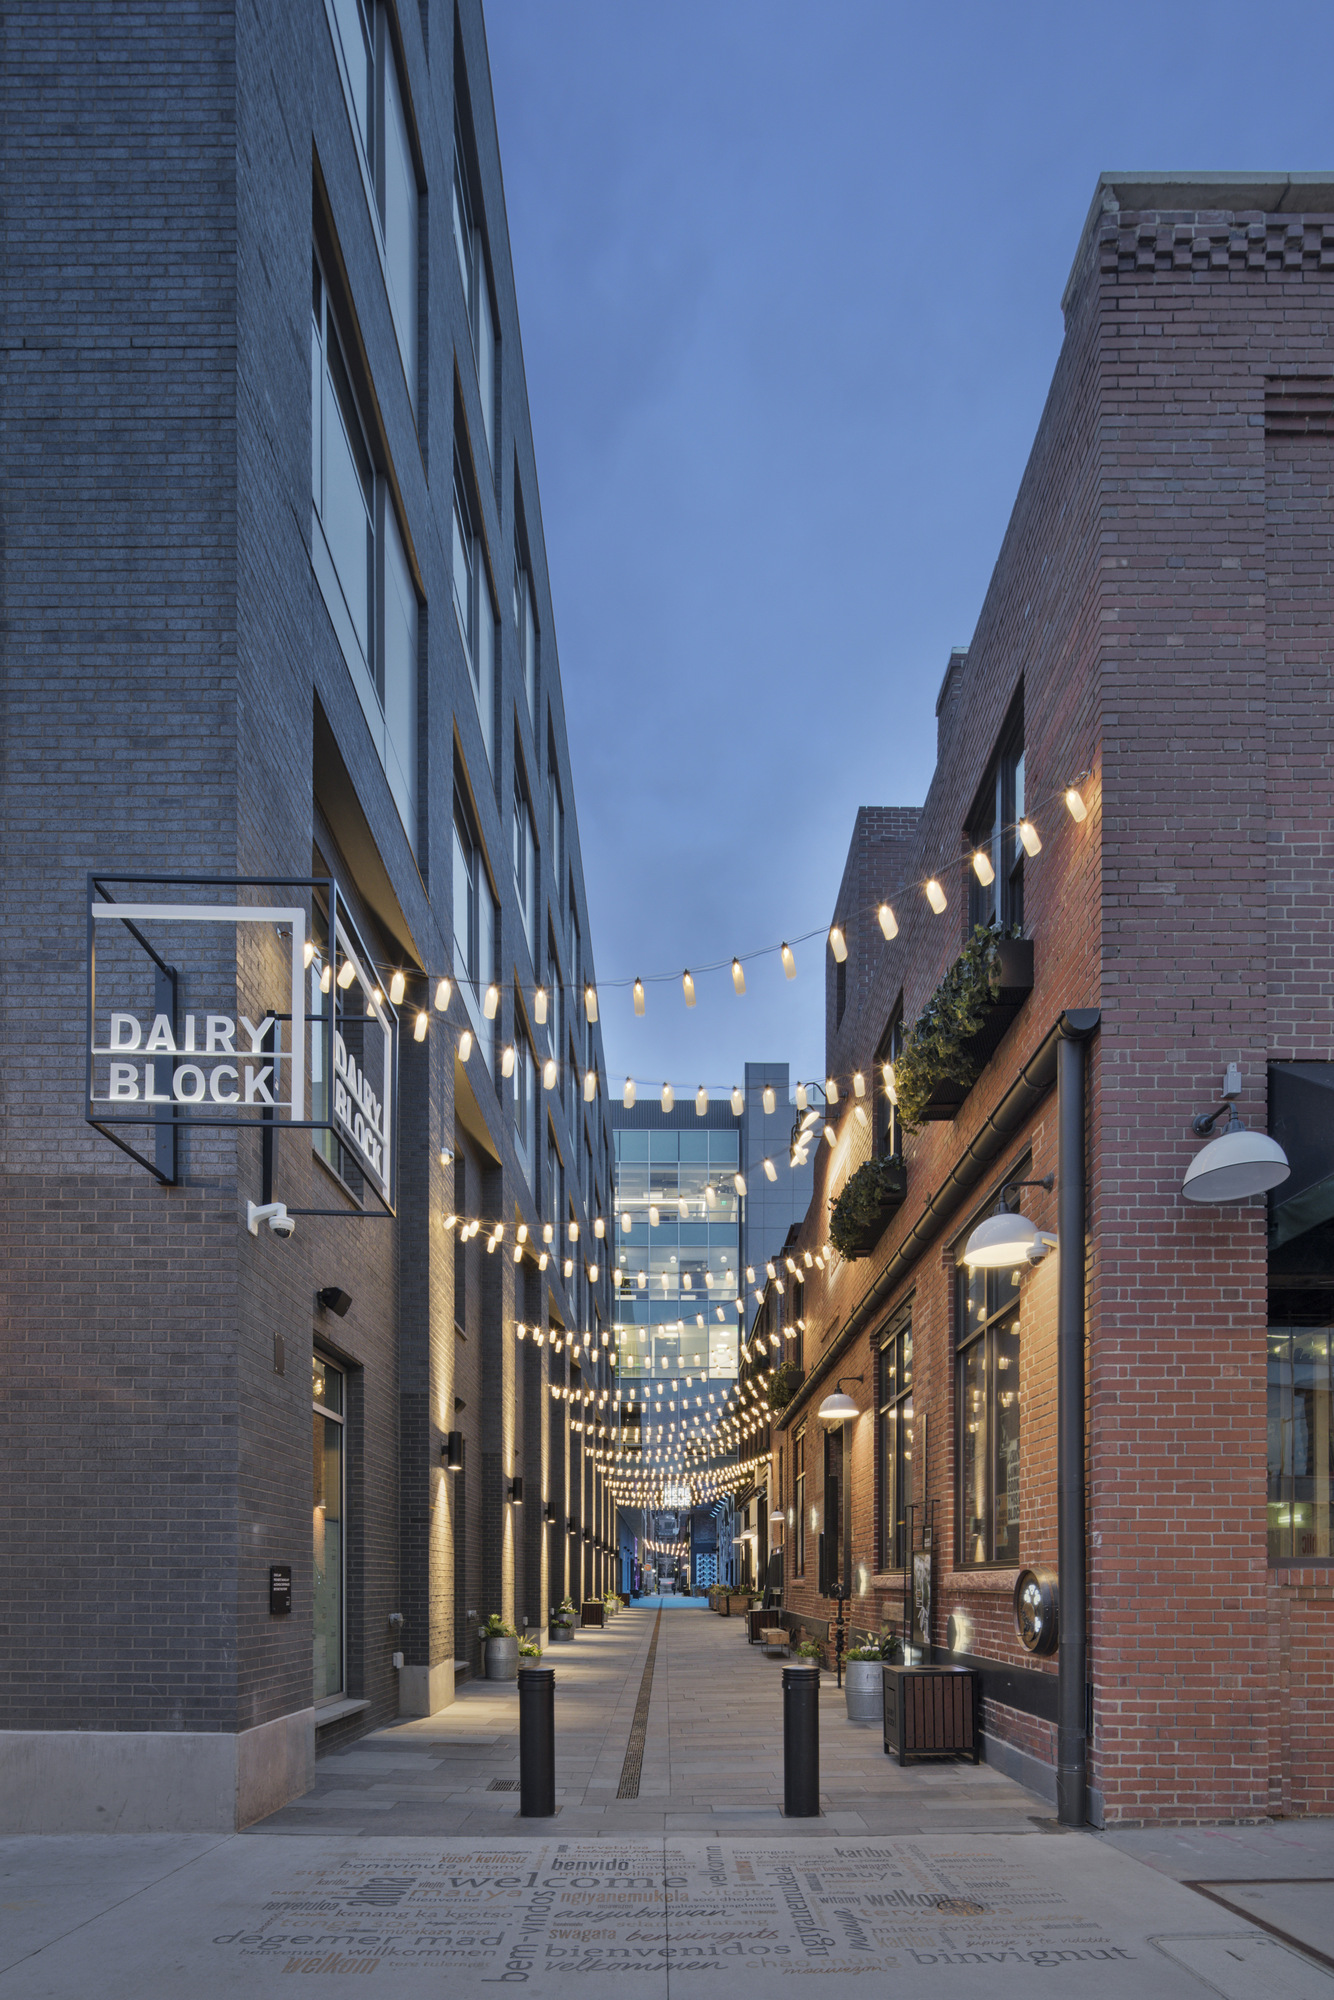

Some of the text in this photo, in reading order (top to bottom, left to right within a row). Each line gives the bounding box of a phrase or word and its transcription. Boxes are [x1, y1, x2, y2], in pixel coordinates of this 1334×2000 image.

[110, 1012, 276, 1053] DAIRY
[109, 1062, 275, 1103] BLOCK
[335, 1030, 382, 1130] DAIRY
[335, 1078, 382, 1172] BLOCK
[439, 1855, 472, 1863] xush
[833, 1847, 893, 1858] karibu
[551, 1858, 630, 1871] benvido
[447, 1871, 689, 1889] welcome
[820, 1872, 904, 1881] mauya
[409, 1889, 523, 1902] mauya
[559, 1889, 690, 1906] ngiyanemukela
[862, 1889, 952, 1908] welkom
[261, 1899, 341, 1911] tervetuloa
[280, 1919, 362, 1932] tonga
[212, 1929, 506, 1951] degemer mad
[548, 1928, 617, 1943] swagata
[347, 1946, 497, 1957] willkommen
[544, 1941, 792, 1958] bienvenidos
[904, 1946, 1138, 1968] binvignut
[280, 1951, 381, 1975] welkom
[543, 1956, 729, 1972] velkommen
